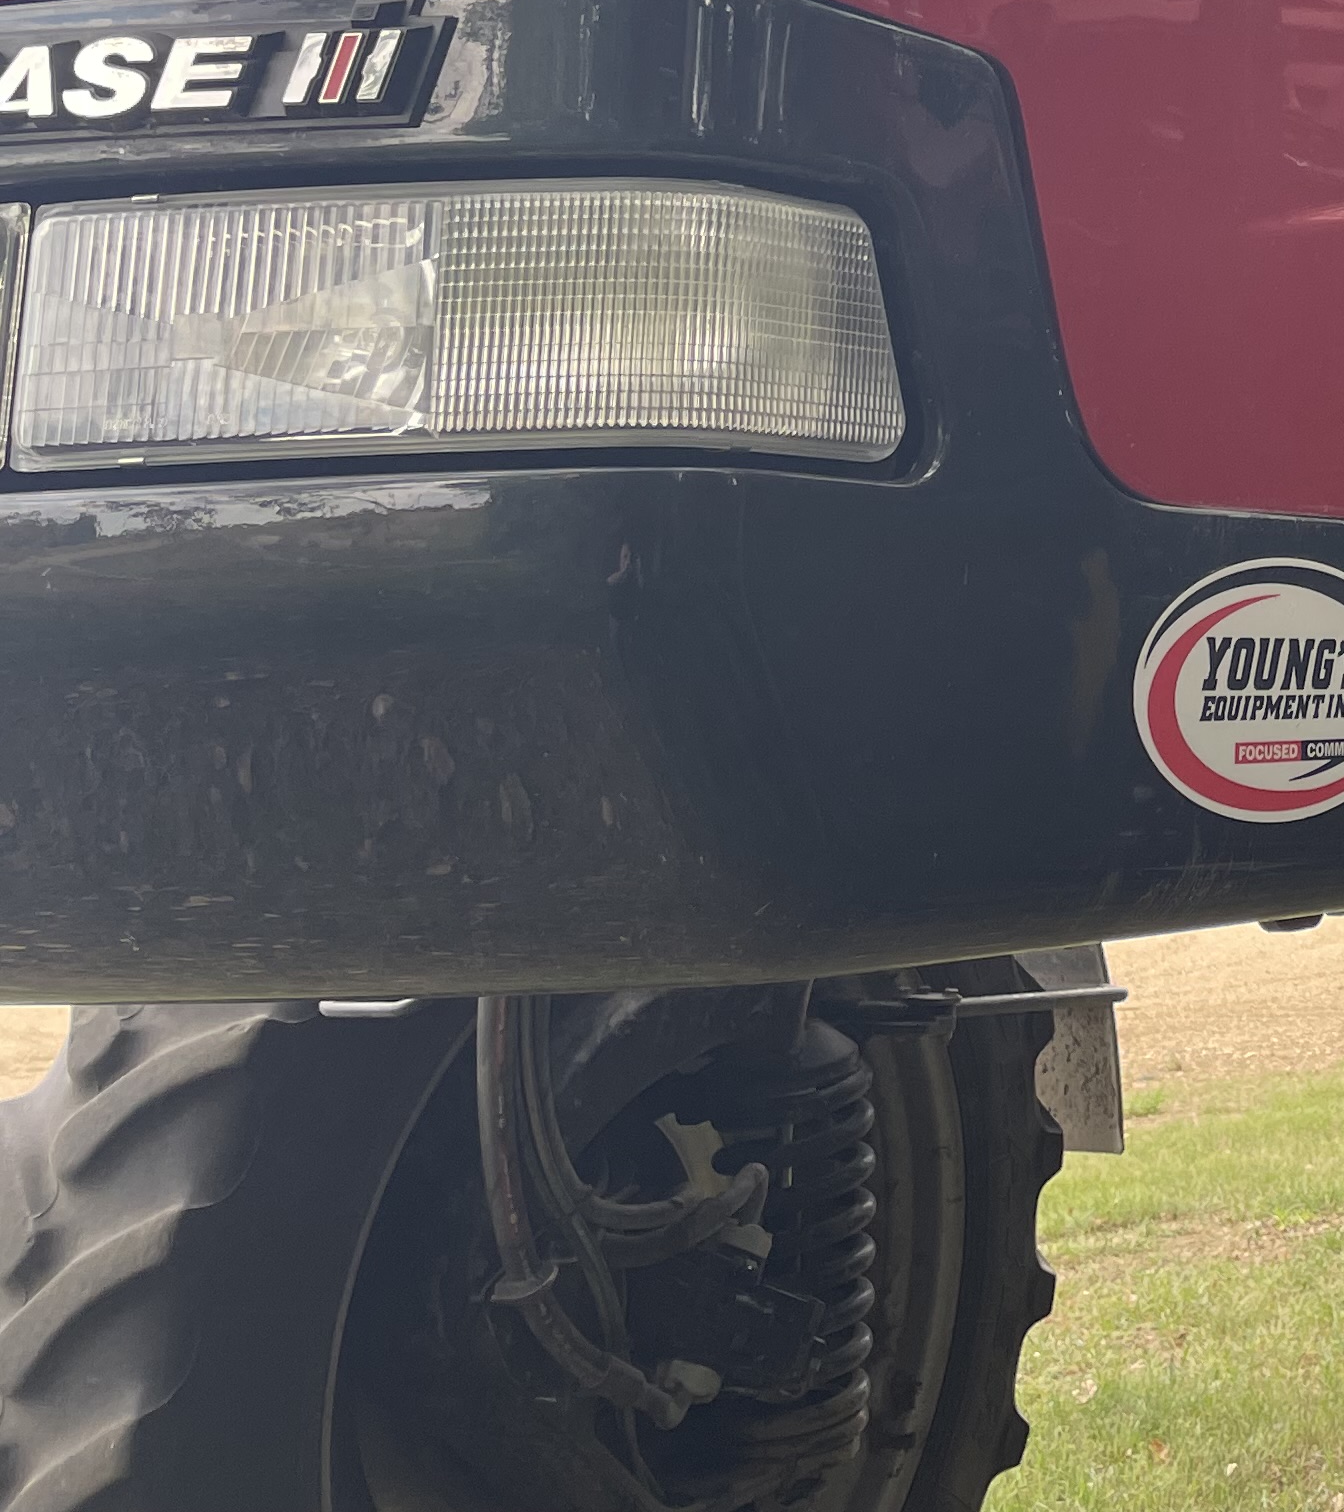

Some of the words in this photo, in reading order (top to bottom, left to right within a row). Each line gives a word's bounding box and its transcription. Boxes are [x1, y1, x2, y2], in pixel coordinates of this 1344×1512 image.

[0, 35, 254, 119] ASE
[1198, 695, 1325, 722] EQUIPMENT
[1238, 743, 1298, 762] FOCUSED
